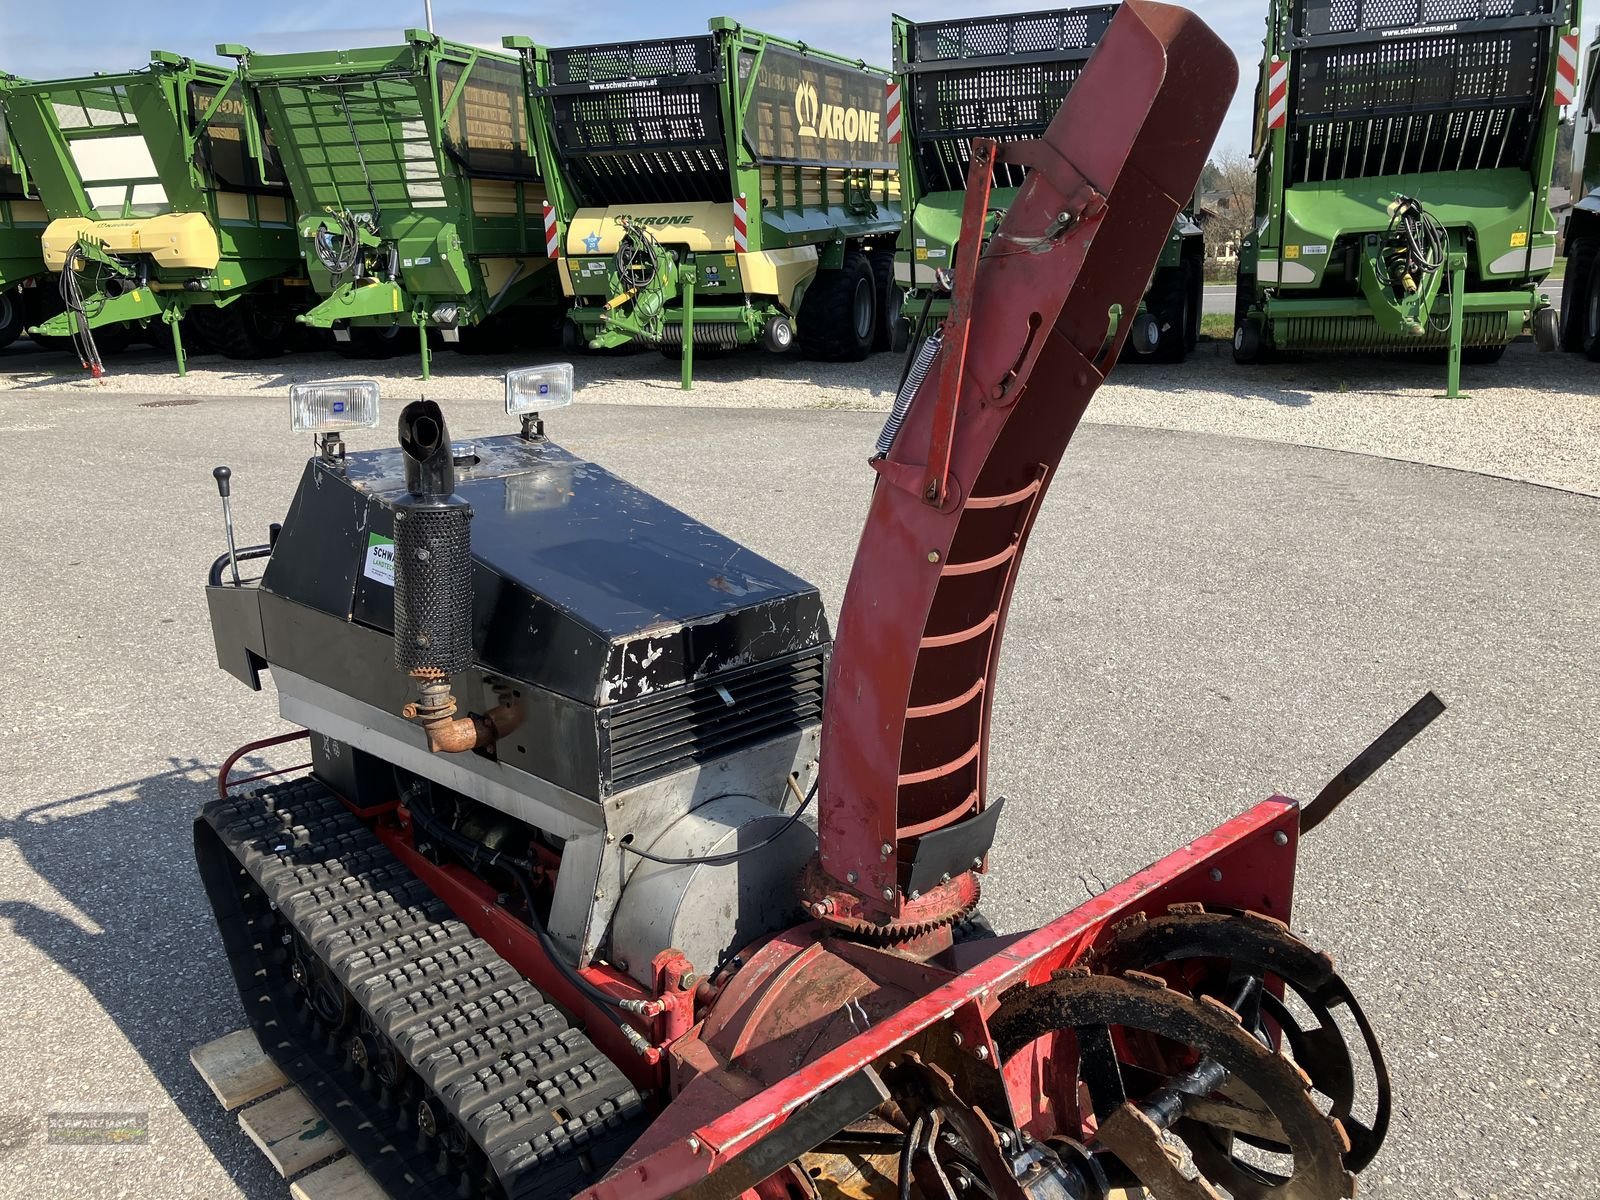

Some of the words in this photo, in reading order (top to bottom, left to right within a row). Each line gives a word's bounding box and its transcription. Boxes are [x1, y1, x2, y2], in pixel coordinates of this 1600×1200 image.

[1381, 23, 1457, 36] www.schwarzmayr.at
[818, 103, 881, 143] KRONE
[633, 215, 694, 226] KRONE
